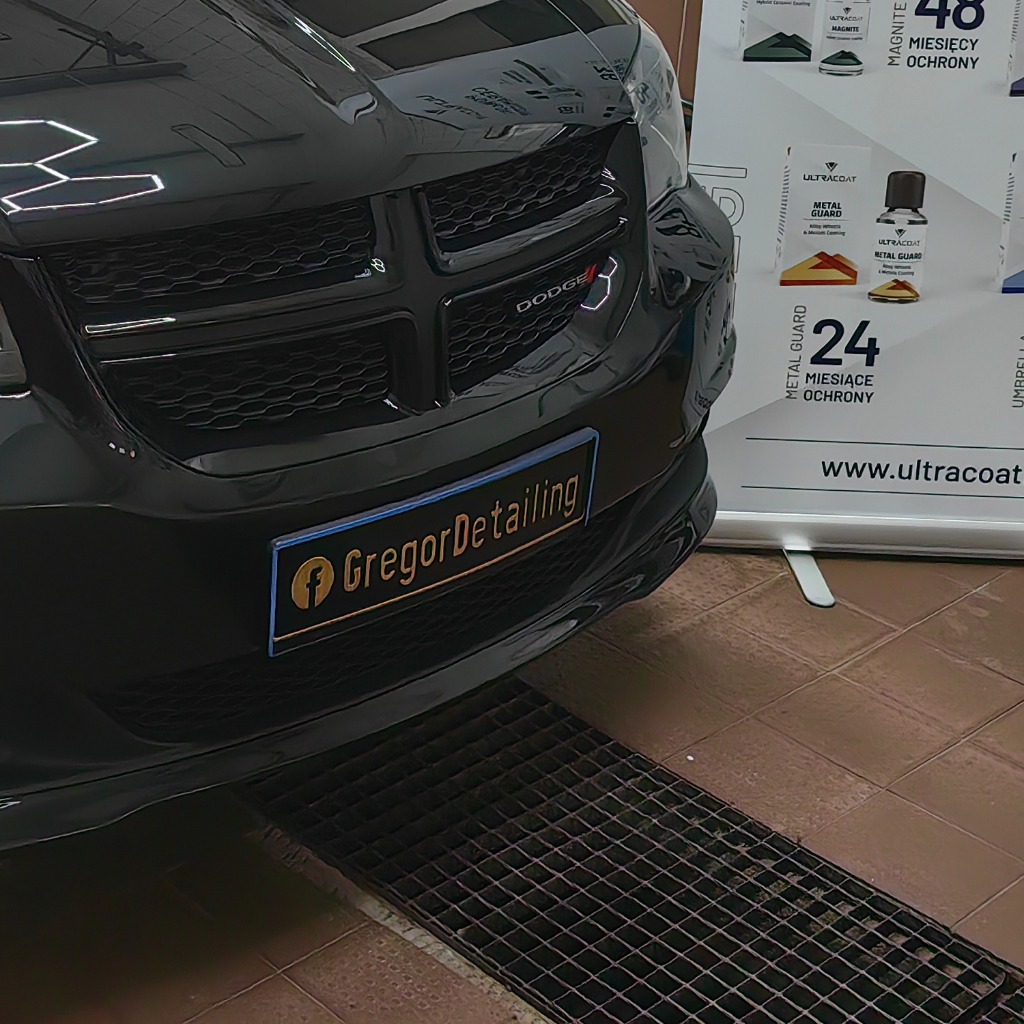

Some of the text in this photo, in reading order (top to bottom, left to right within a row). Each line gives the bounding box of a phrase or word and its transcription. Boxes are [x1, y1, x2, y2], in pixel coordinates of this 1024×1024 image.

[831, 25, 860, 33] MAGNITE
[887, 1, 907, 67] MAGNITE
[908, 37, 979, 53] MIESIĘCY
[906, 55, 980, 70] OCHRONY
[802, 174, 857, 183] ULTRACOAT
[813, 201, 842, 210] METAL
[811, 209, 842, 218] GUARD
[878, 239, 921, 247] ULTRACOAT
[874, 250, 922, 260] METAL GUARD
[516, 271, 587, 313] DODGE
[809, 318, 880, 367] 24
[785, 305, 807, 400] METAL GUARD
[805, 372, 874, 389] MIESIĄCE
[803, 389, 875, 404] OCHRONY
[821, 459, 1024, 485] www.ultracoat
[343, 474, 579, 593] GregorDetailing
